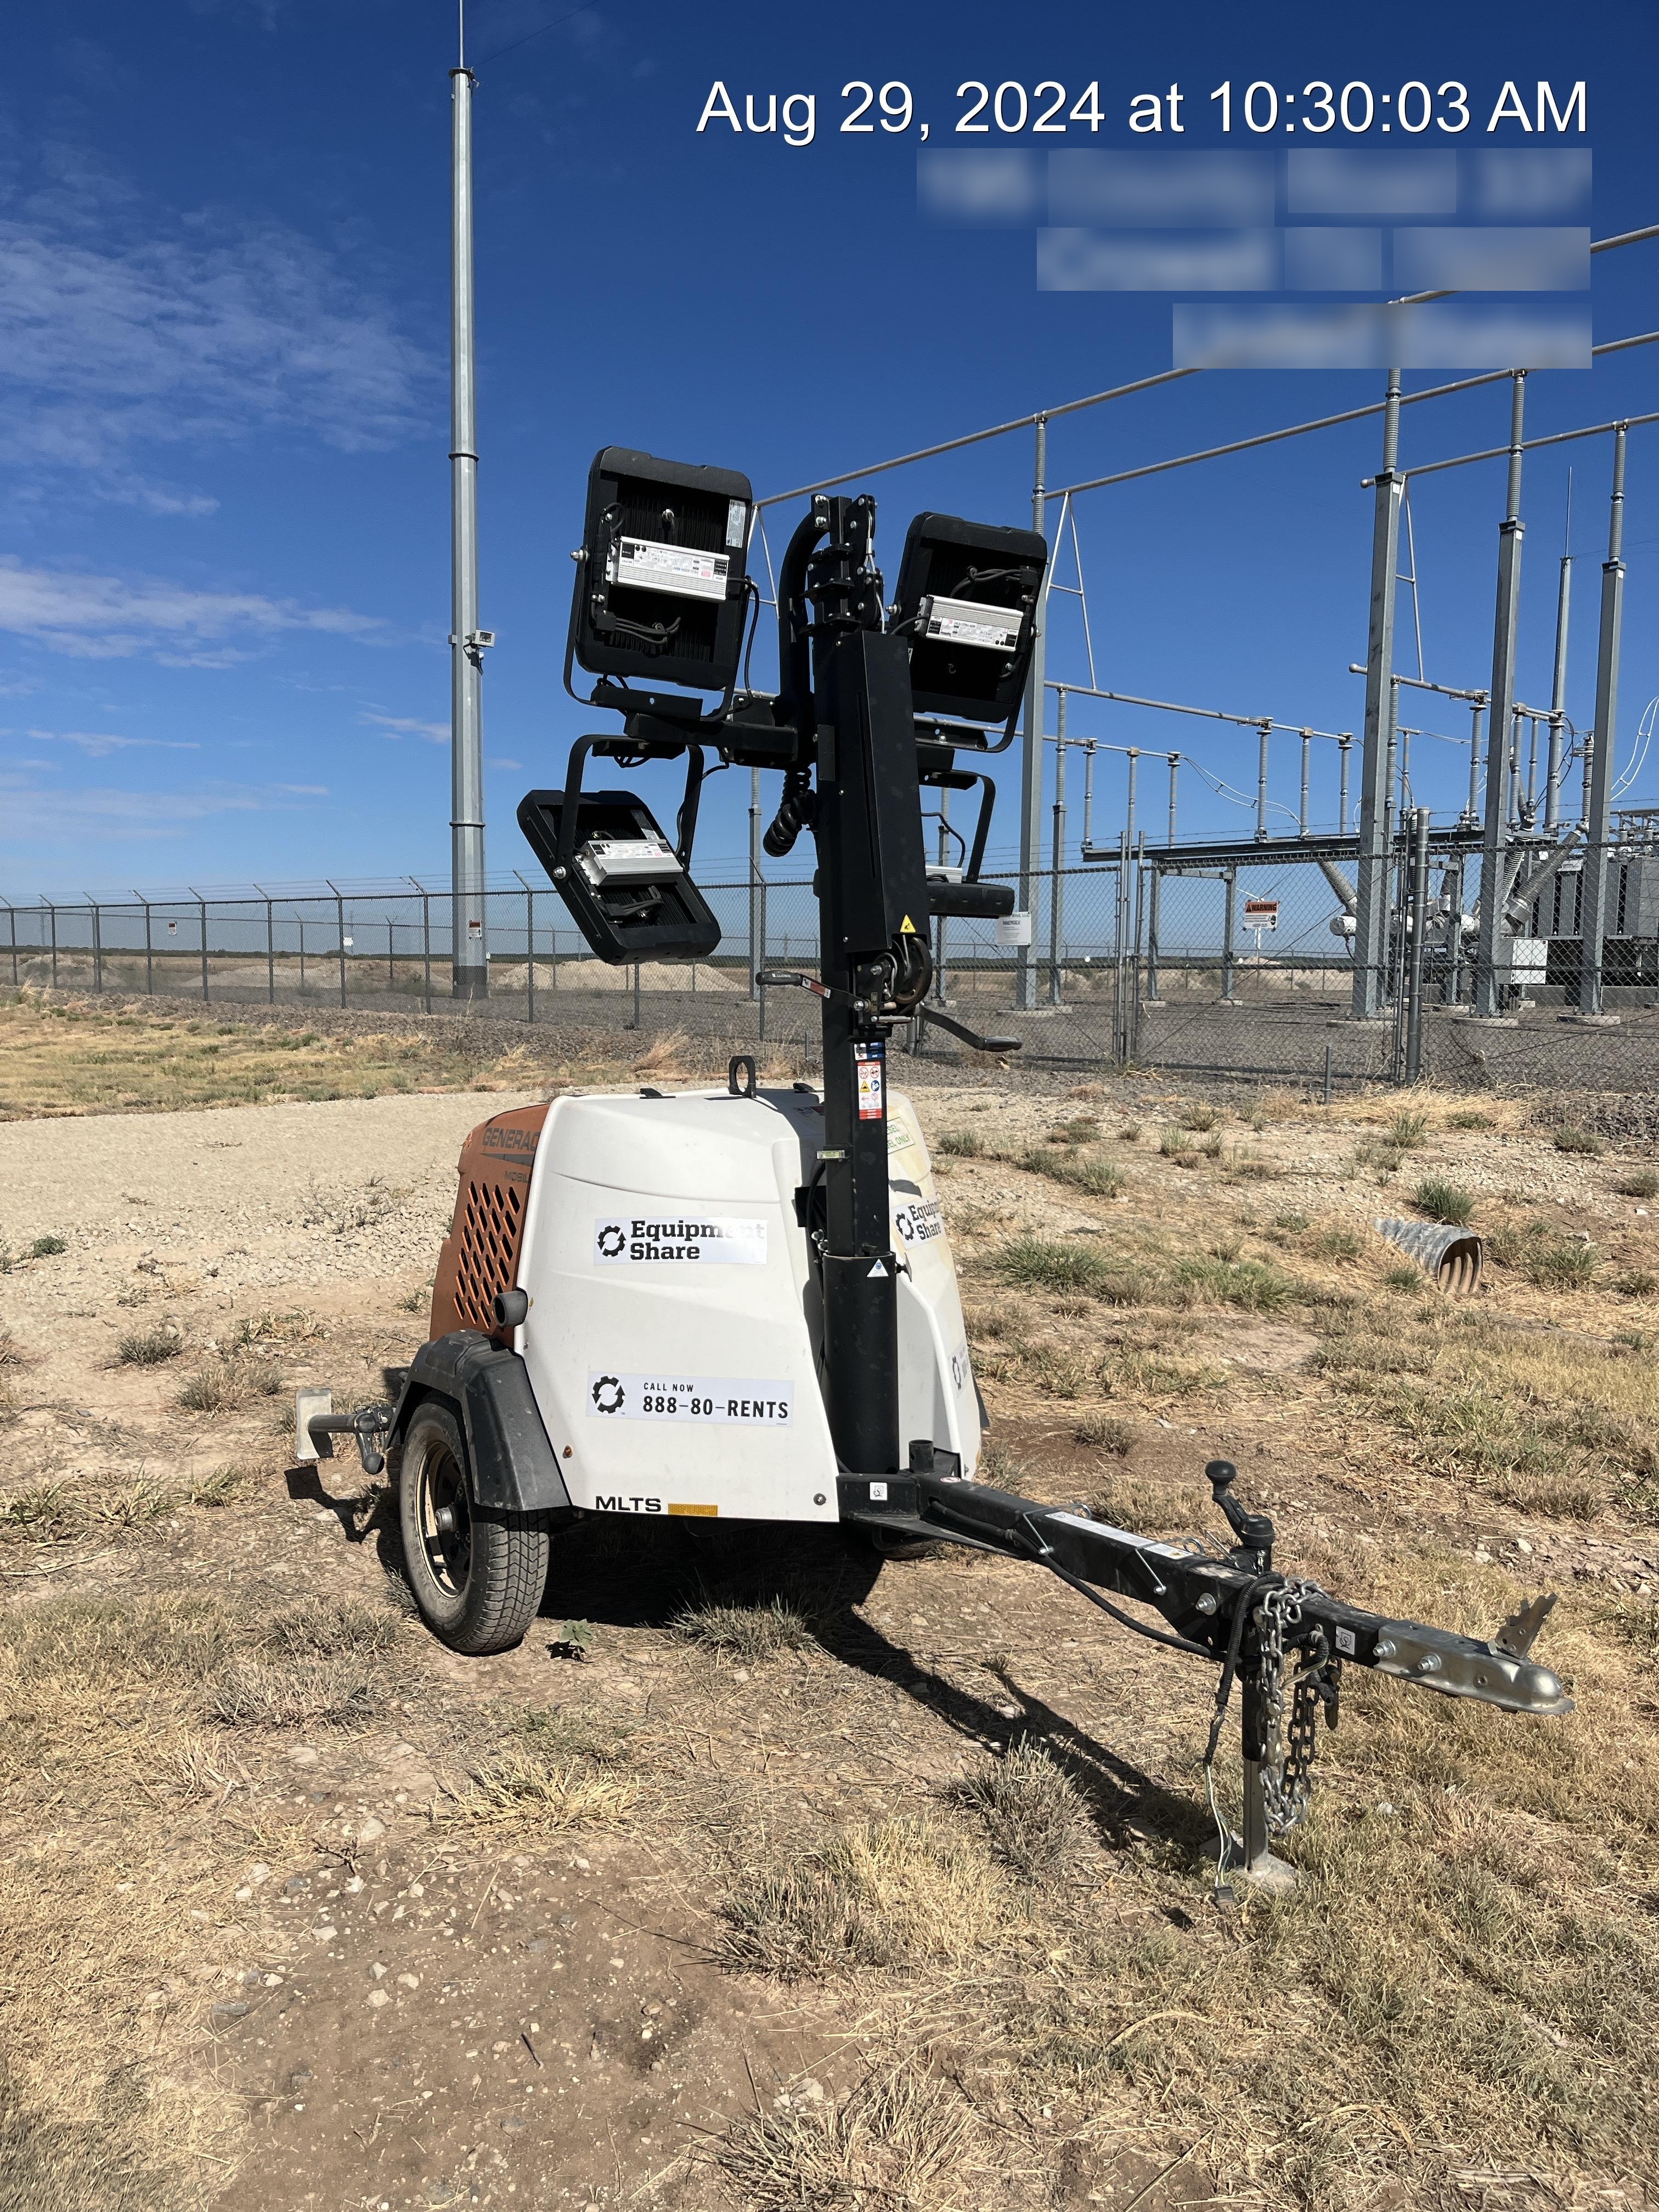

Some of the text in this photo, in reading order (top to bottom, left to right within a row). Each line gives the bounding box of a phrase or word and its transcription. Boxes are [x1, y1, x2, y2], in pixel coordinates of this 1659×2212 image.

[482, 1127, 541, 1151] GENERAC
[895, 1133, 910, 1145] ONLY
[631, 1220, 764, 1241] Equipmt
[916, 1222, 941, 1240] Share
[630, 1242, 700, 1260] Share
[644, 1382, 694, 1392] CALL NOW
[642, 1395, 788, 1419] 888-80-RENTS
[596, 1496, 661, 1511] MLTS
